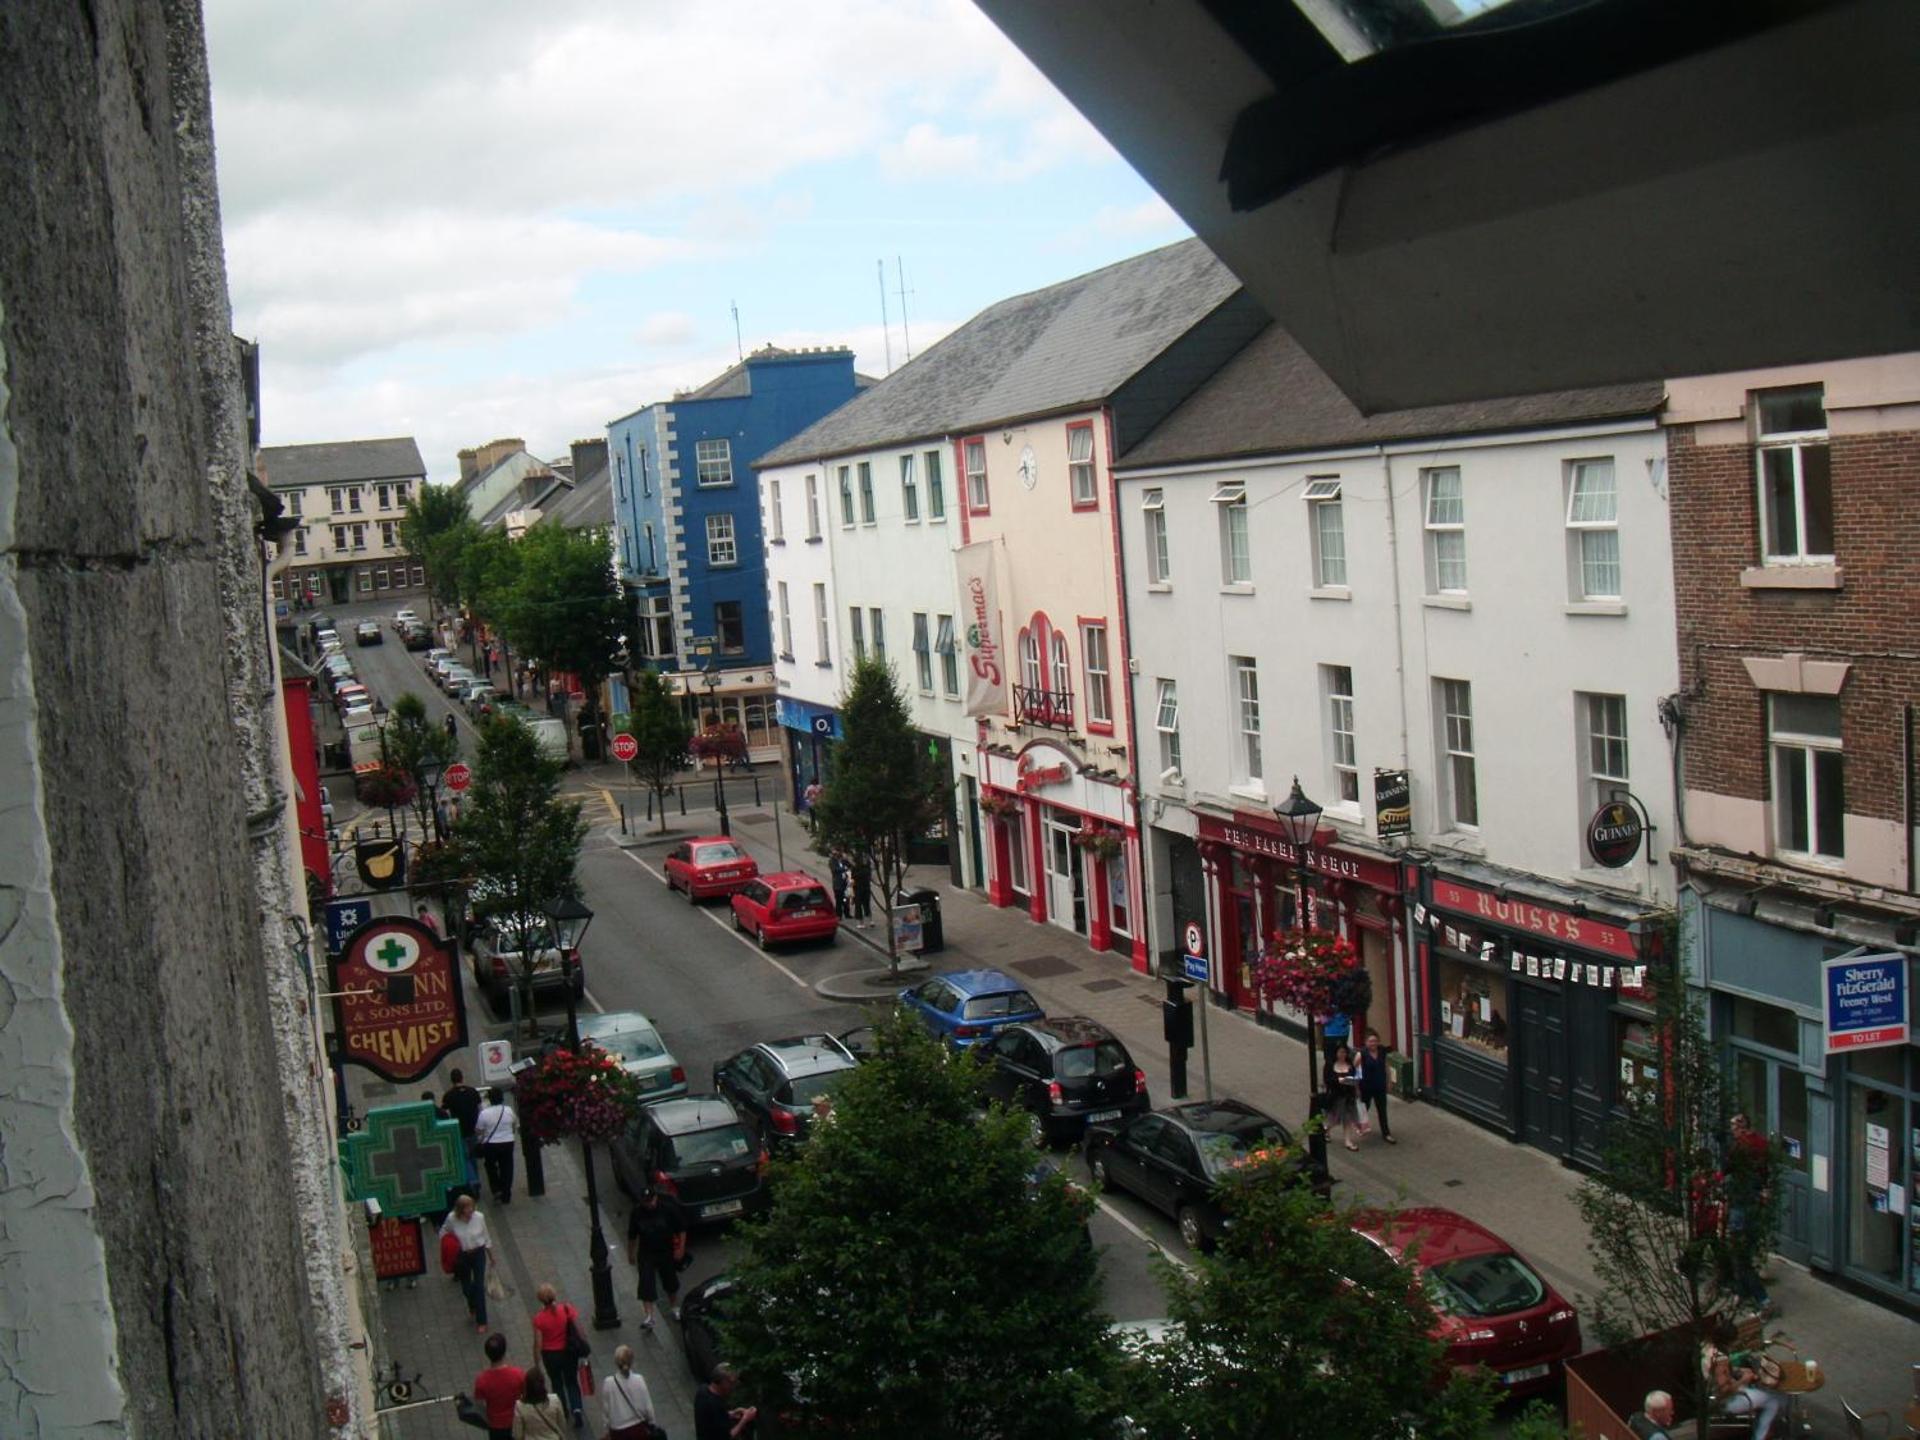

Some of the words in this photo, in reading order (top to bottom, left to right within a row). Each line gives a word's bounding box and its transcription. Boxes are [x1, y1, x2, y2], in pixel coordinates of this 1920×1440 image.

[613, 742, 635, 752] STOP
[1255, 836, 1315, 866] FASHIN
[1844, 967, 1885, 982] Sherry
[1836, 977, 1896, 996] FitzGerald
[369, 1004, 411, 1020] SONS
[350, 1021, 454, 1065] CHEMIST
[1851, 1034, 1864, 1043] TO
[1865, 1032, 1881, 1041] LET
